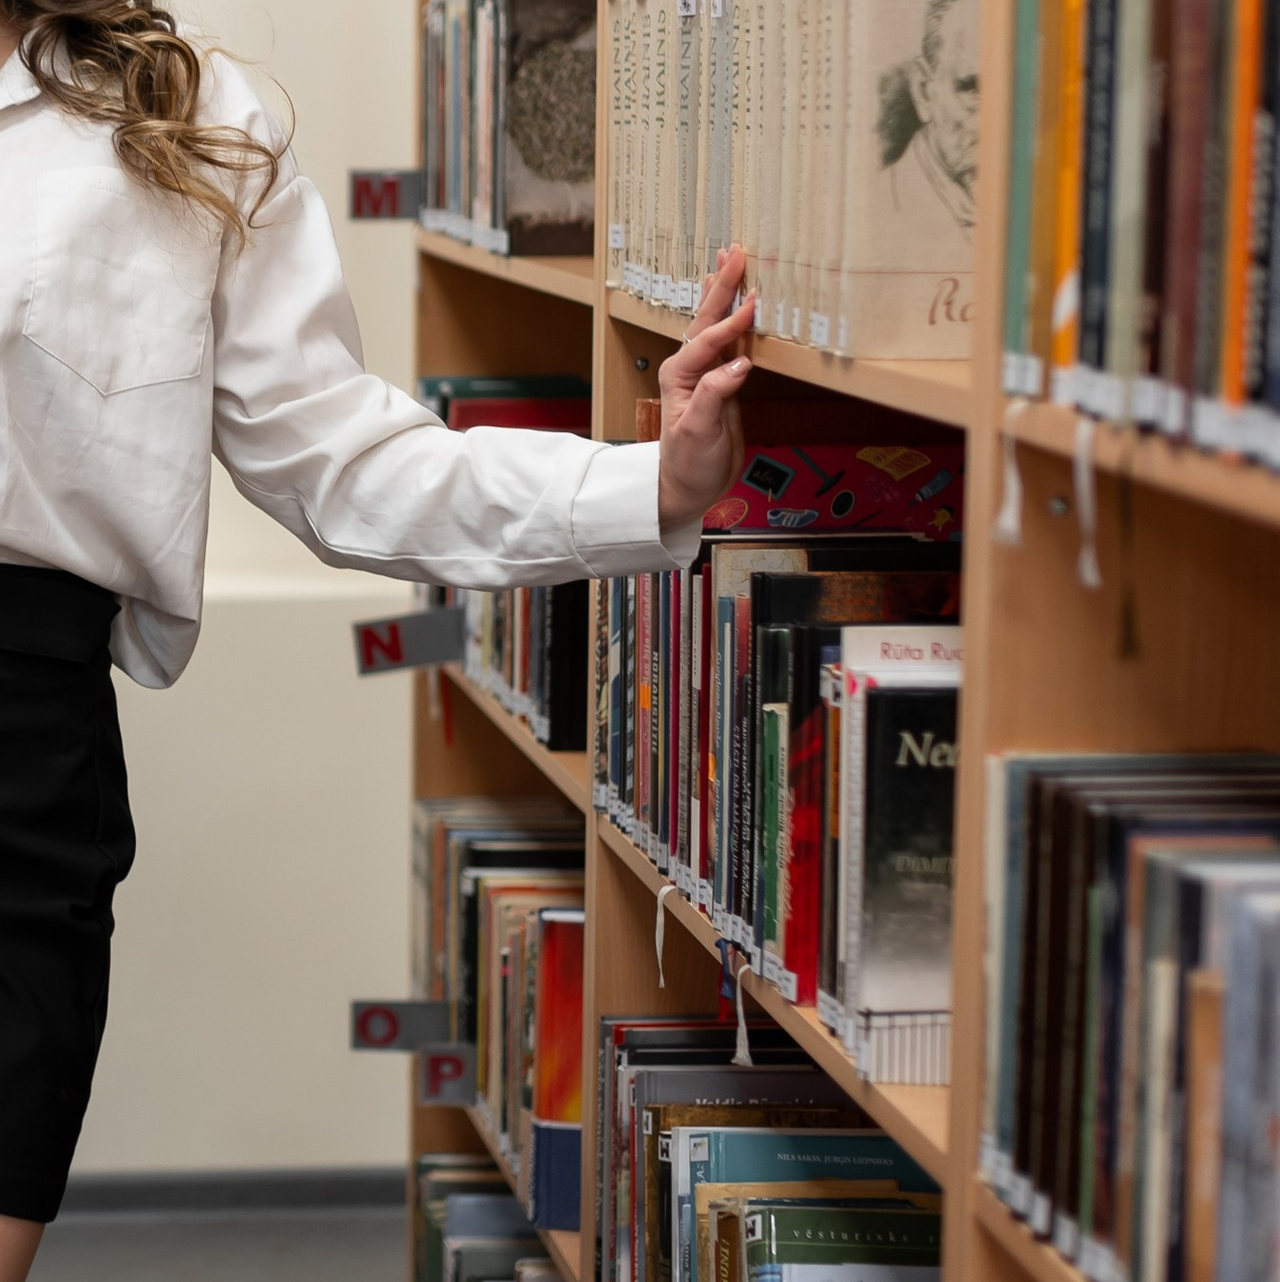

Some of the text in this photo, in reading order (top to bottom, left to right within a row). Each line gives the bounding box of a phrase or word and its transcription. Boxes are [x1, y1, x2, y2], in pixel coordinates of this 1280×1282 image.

[355, 179, 397, 215] M
[361, 624, 402, 666] N
[881, 642, 925, 660] Rūta
[357, 1007, 398, 1047] O
[428, 1054, 465, 1096] P
[776, 1153, 795, 1161] NILS
[792, 1228, 908, 1242] vēsturisks
